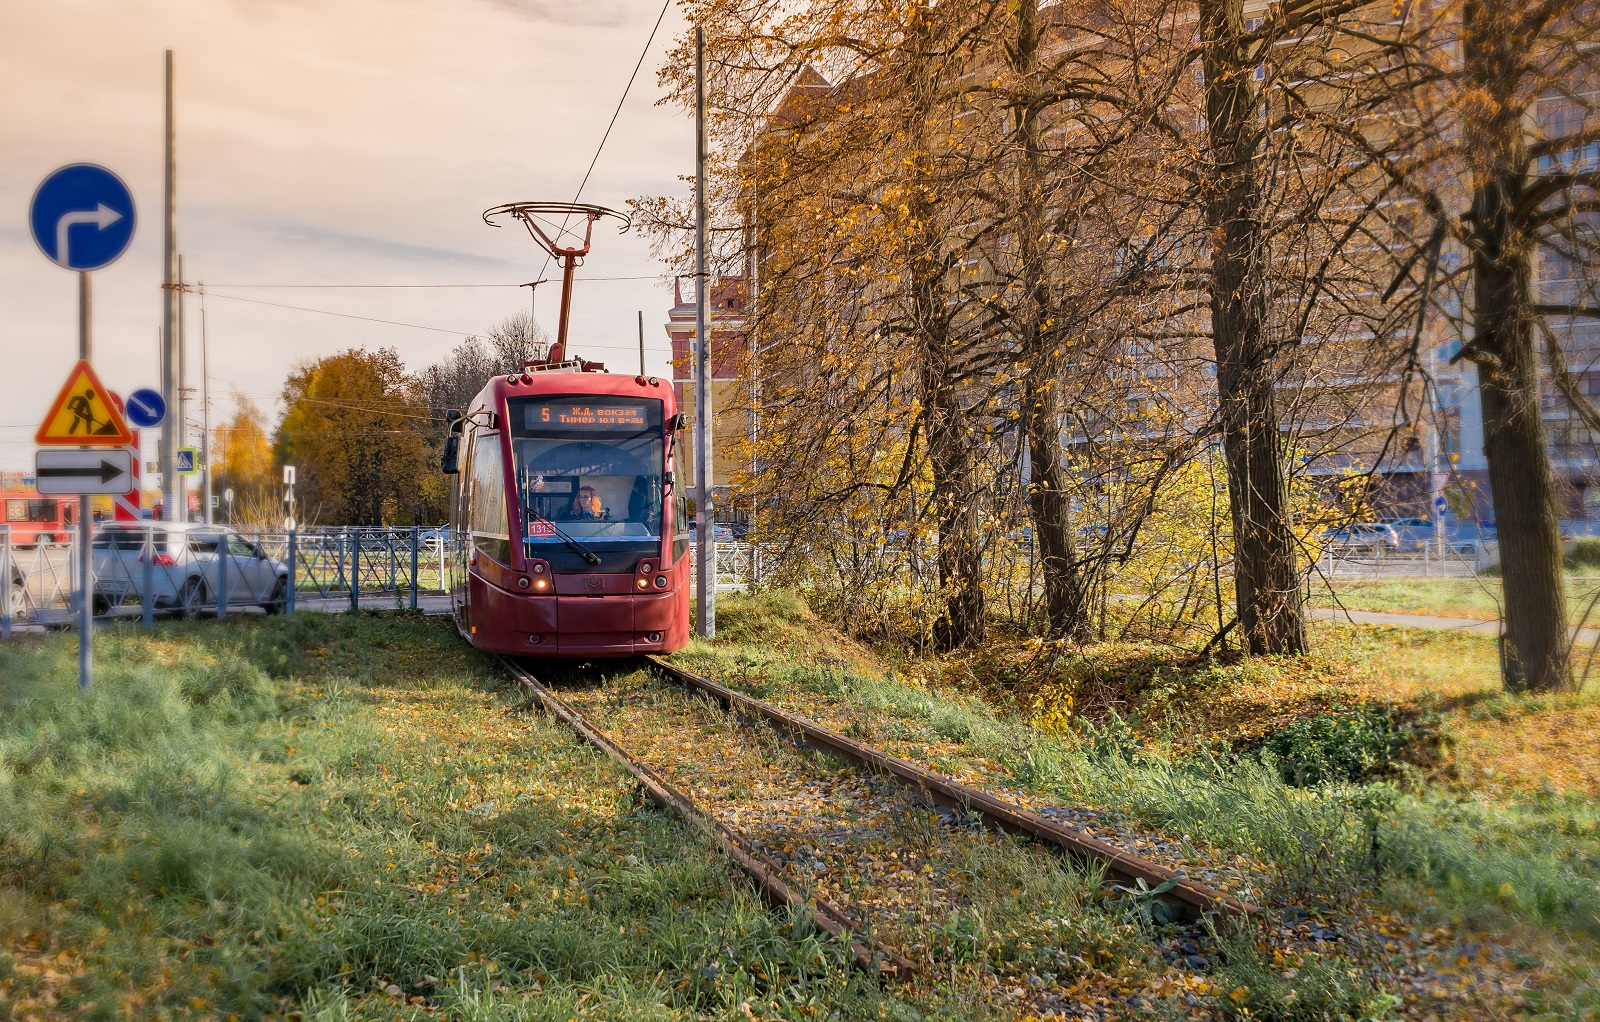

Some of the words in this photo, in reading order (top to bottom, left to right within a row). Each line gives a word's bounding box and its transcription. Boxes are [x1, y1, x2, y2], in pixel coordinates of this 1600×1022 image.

[542, 408, 550, 422] 5
[572, 407, 594, 417] Ж.Д.
[560, 414, 596, 424] Тимер
